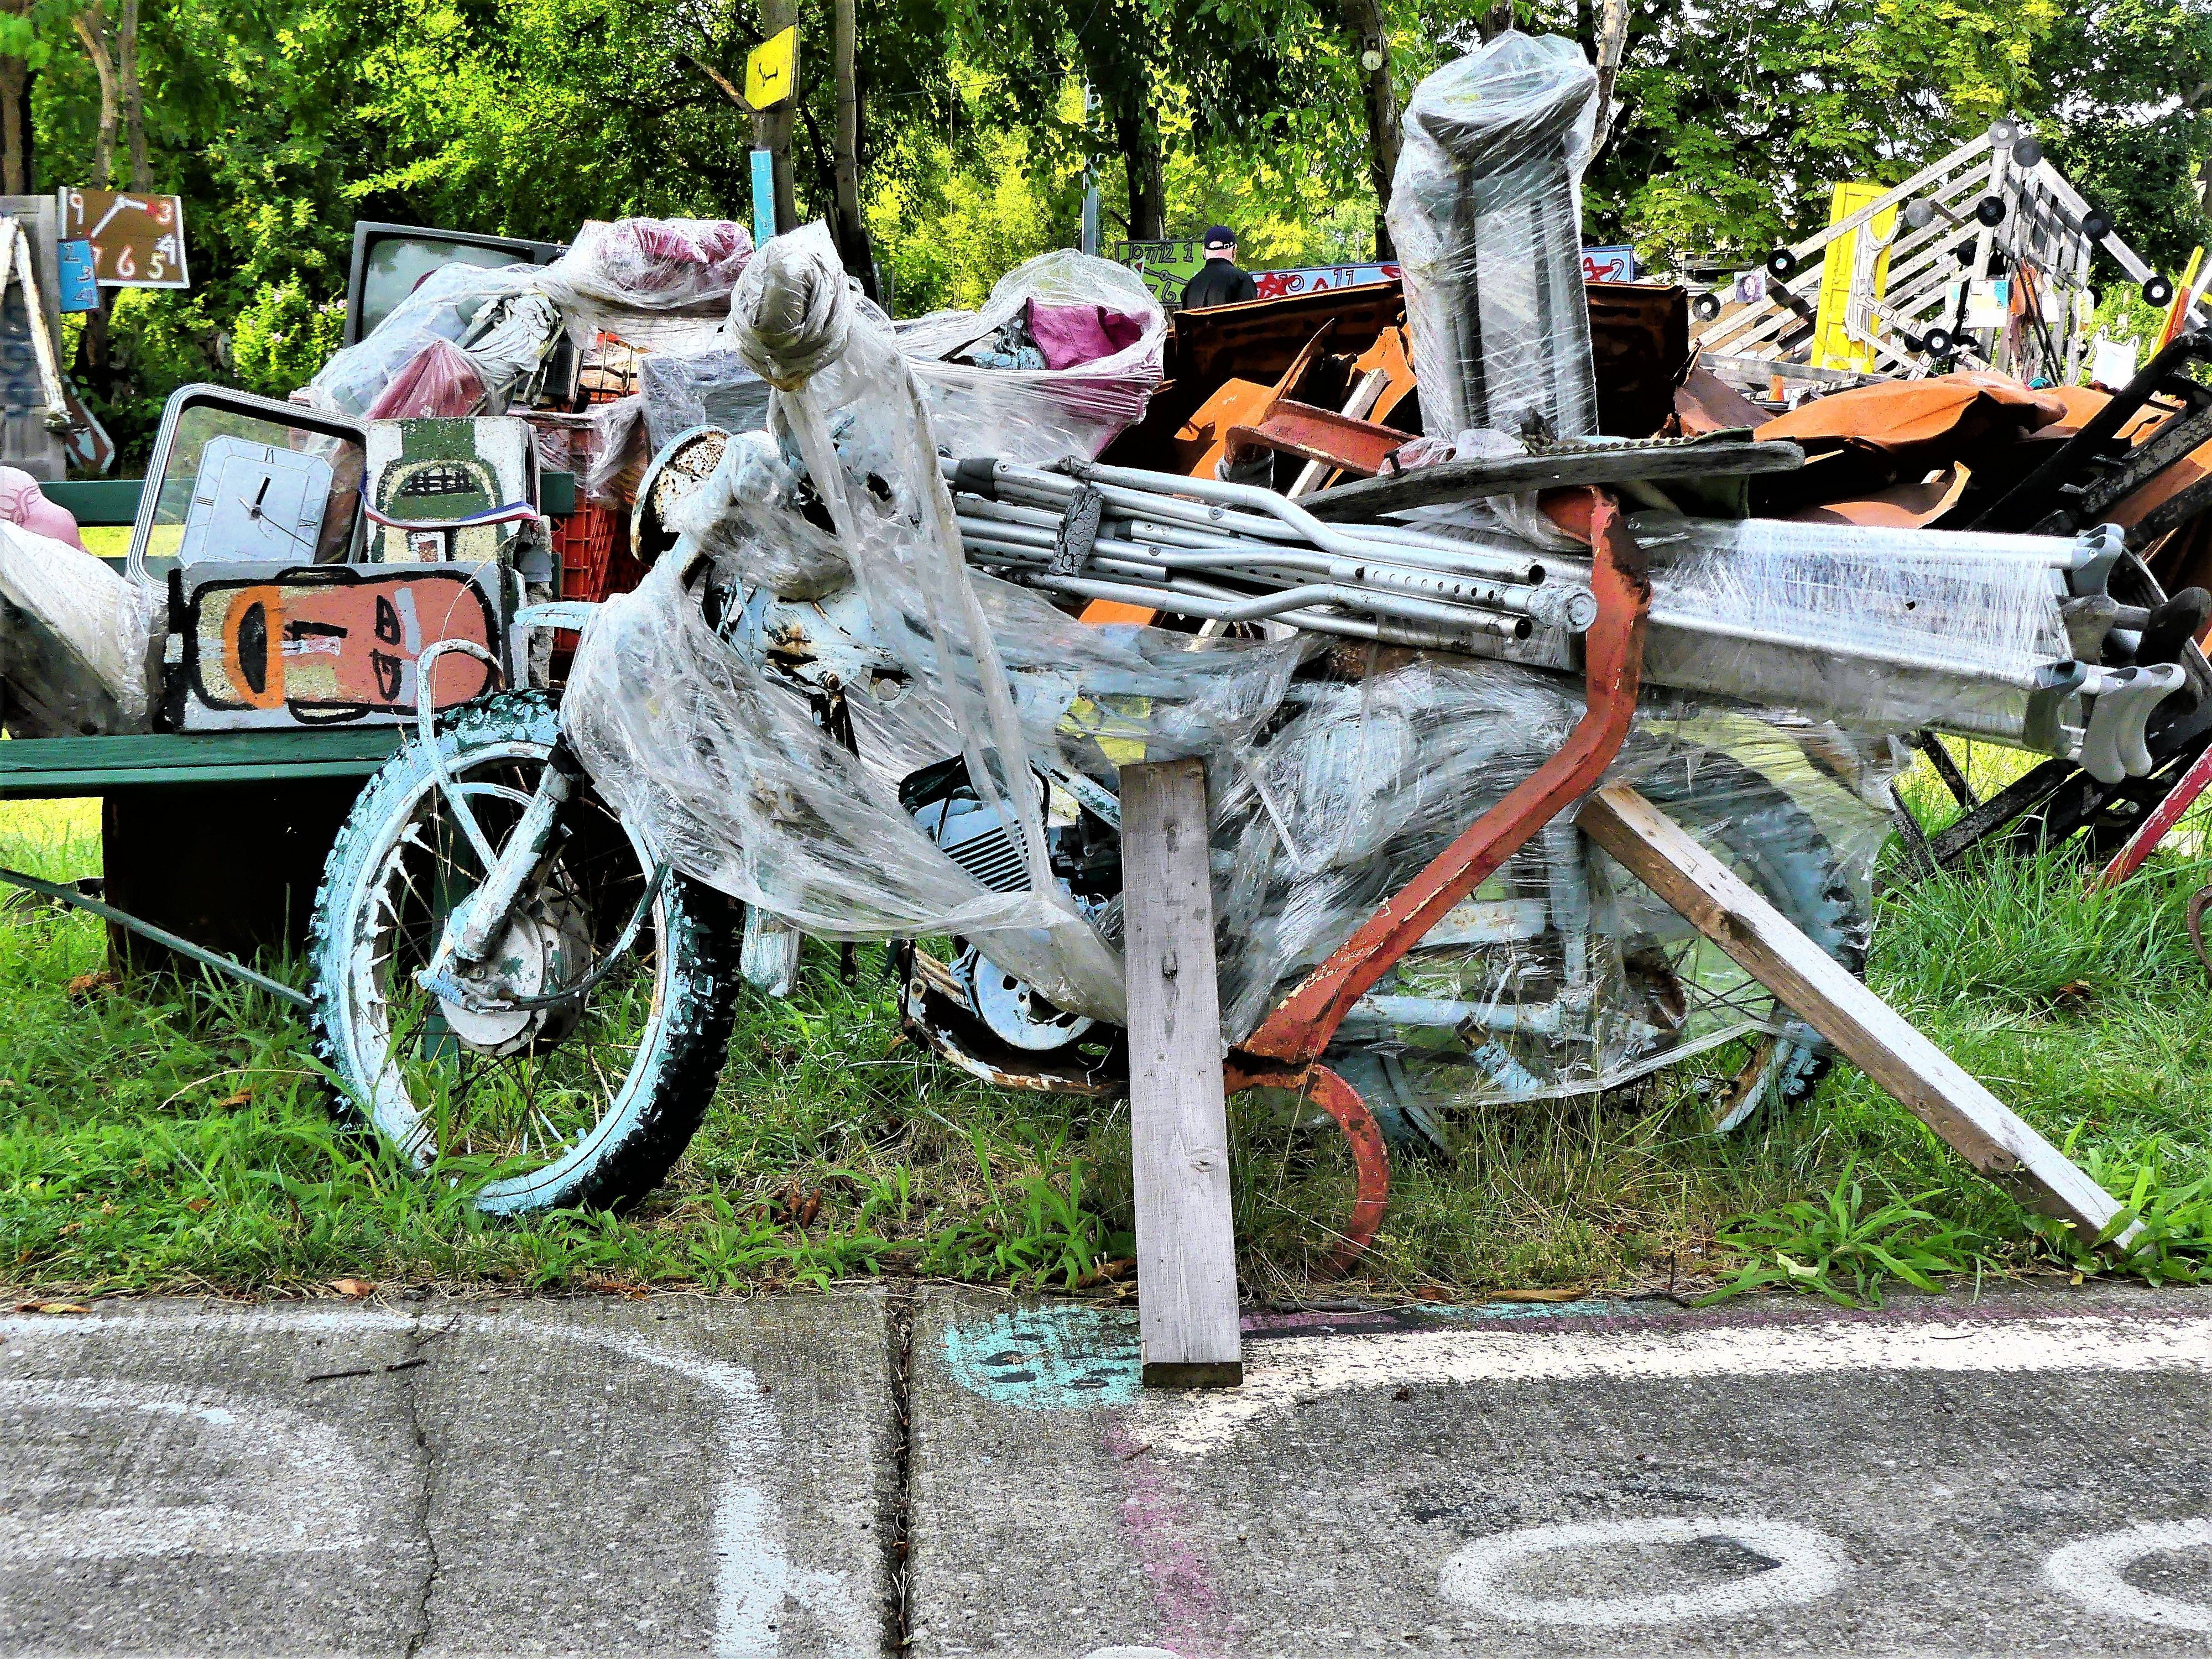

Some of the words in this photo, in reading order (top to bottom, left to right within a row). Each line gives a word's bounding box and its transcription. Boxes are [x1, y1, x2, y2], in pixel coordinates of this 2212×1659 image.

[69, 192, 84, 225] 9
[156, 201, 174, 225] 3
[116, 246, 136, 279] 6
[148, 253, 166, 279] 5
[1161, 281, 1177, 302] 6
